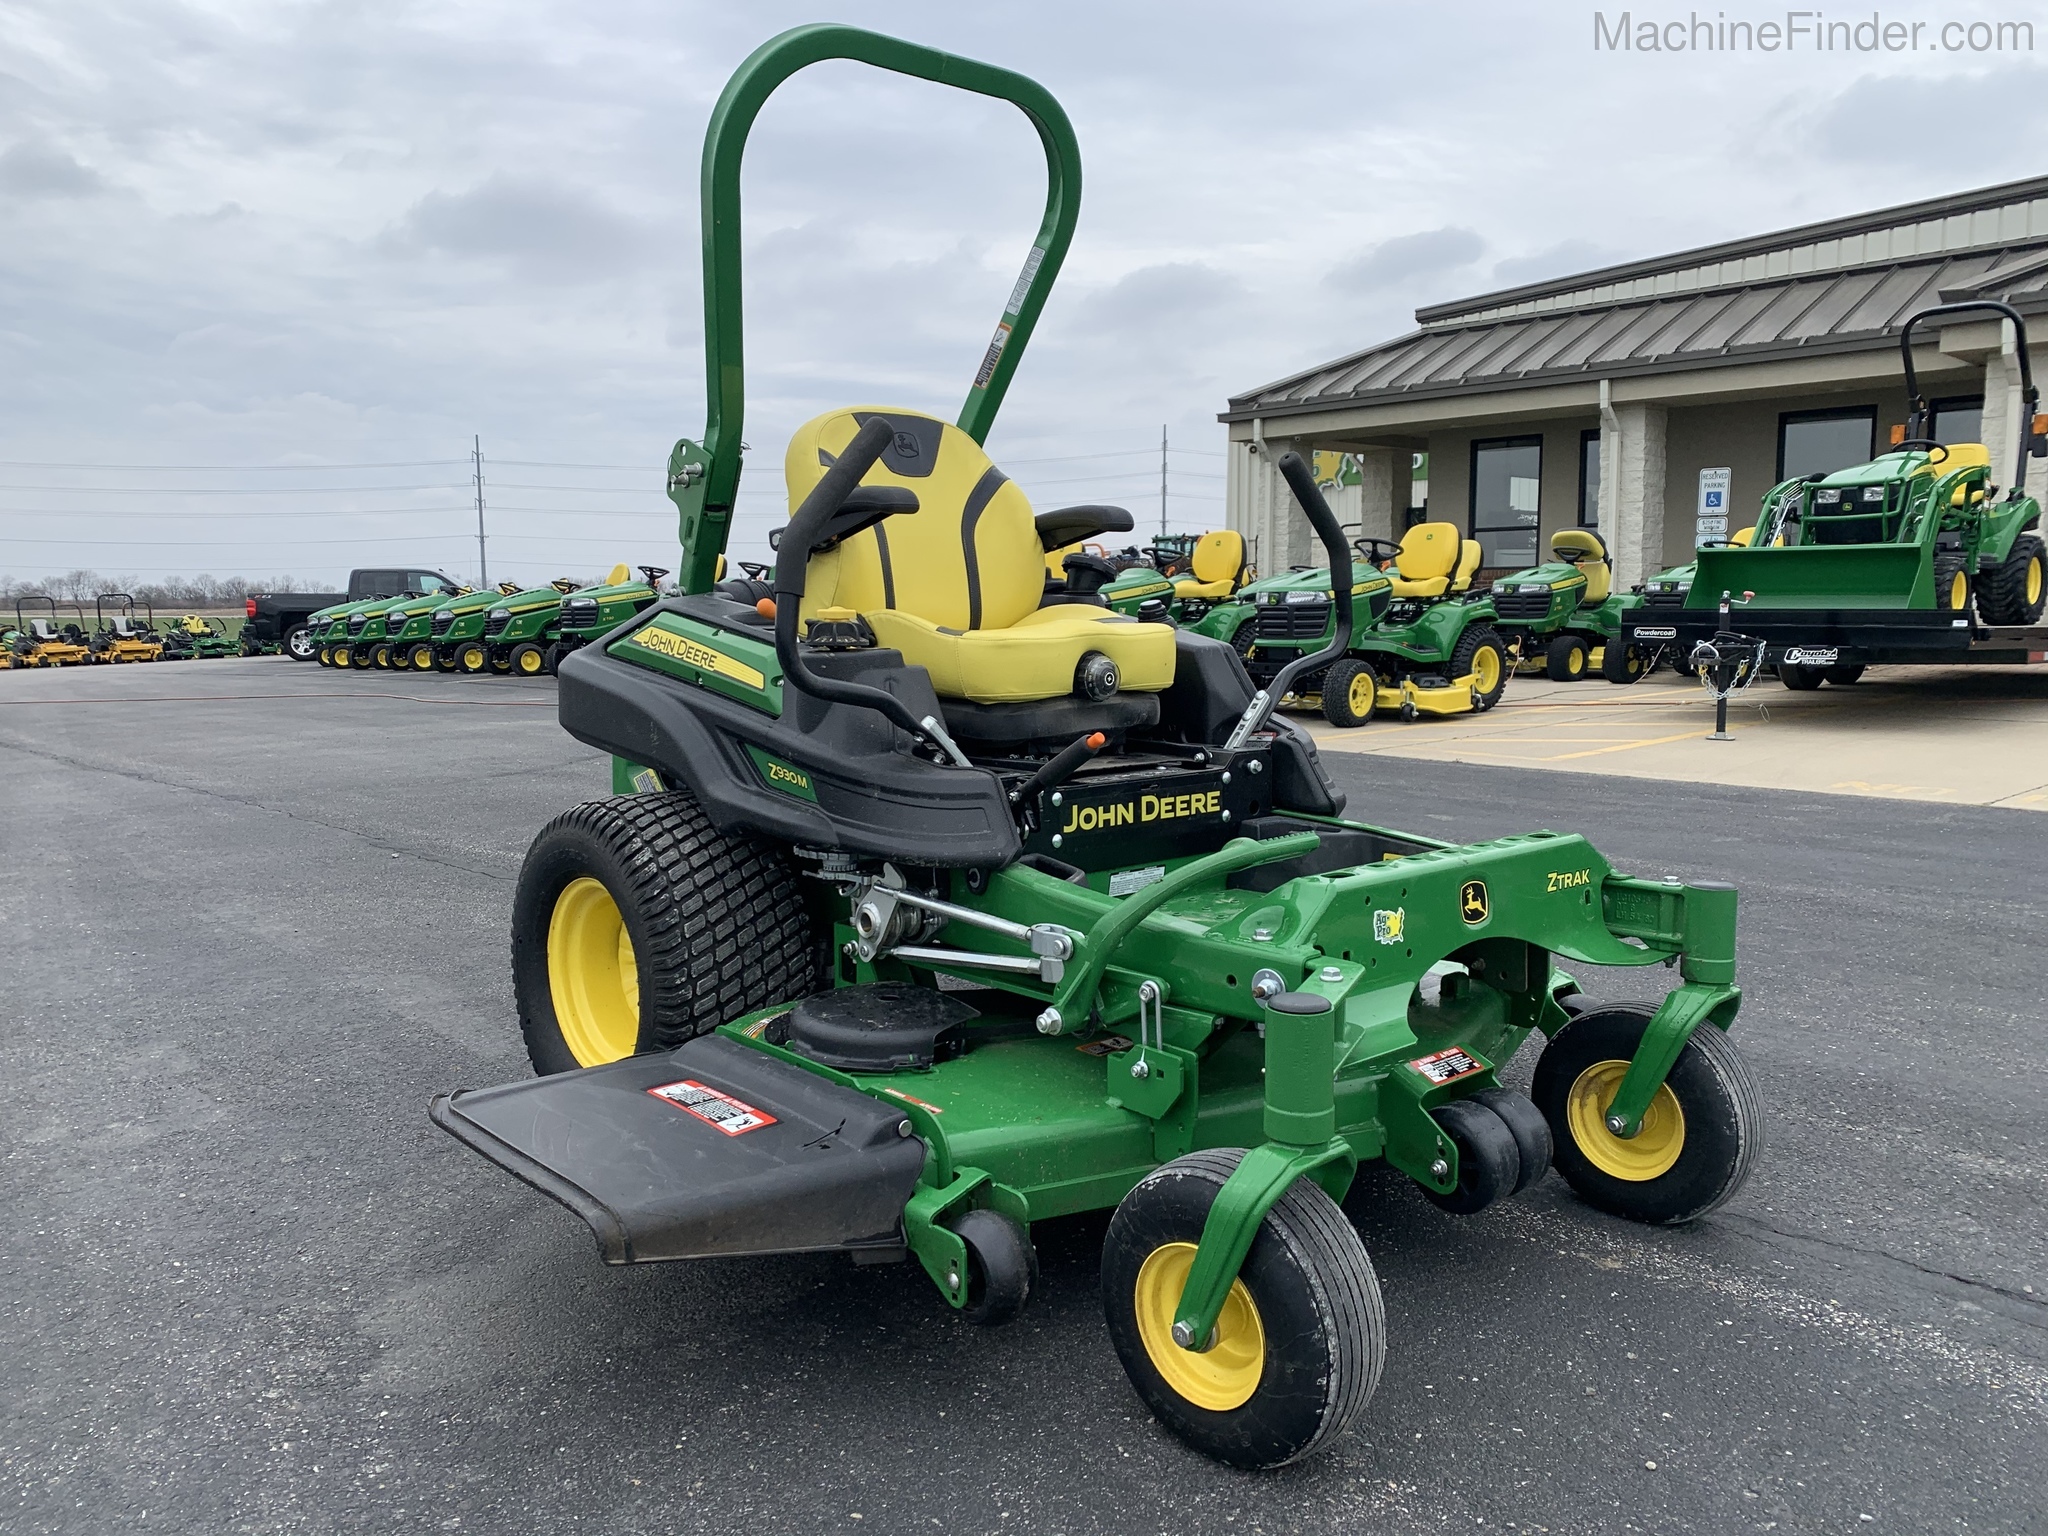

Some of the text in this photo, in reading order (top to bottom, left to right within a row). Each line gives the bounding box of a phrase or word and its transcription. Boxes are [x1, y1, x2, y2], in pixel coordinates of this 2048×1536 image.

[1702, 472, 1728, 480] RESERVED
[643, 630, 717, 669] JOHN DEERE
[768, 762, 808, 789] Z930M
[1063, 791, 1221, 833] JOHN DEERE
[1547, 868, 1590, 892] ZTRAK
[1376, 925, 1391, 938] Pro
